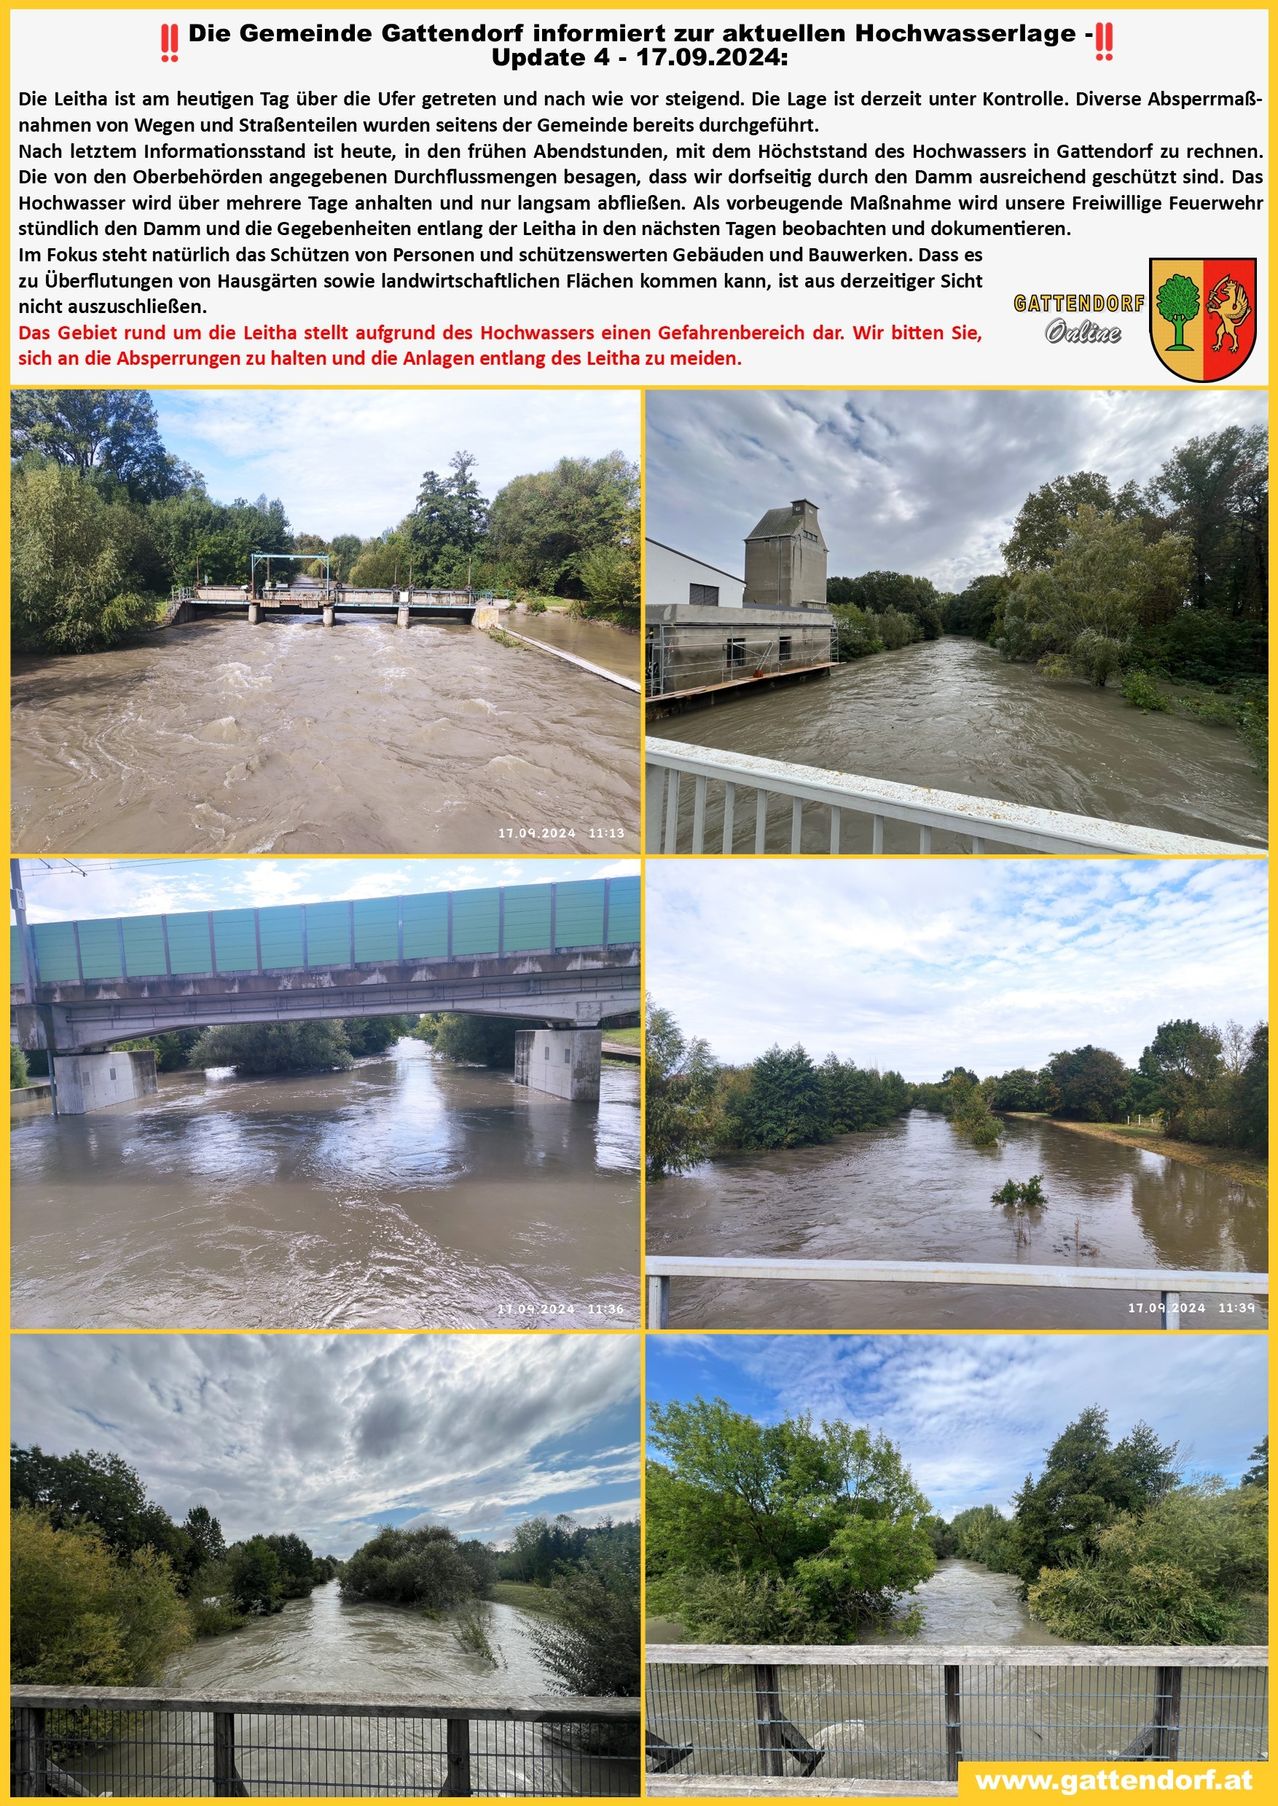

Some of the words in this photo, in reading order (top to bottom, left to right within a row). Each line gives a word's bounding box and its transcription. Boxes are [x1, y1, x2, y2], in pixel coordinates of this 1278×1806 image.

[189, 23, 231, 43] Die
[239, 23, 373, 43] Gemeinde
[381, 23, 525, 43] Gattendorf
[533, 23, 666, 43] informiert
[673, 28, 715, 43] zur
[722, 23, 846, 43] aktuellen
[855, 23, 1077, 47] Hochwasserlage
[492, 47, 586, 71] Update
[593, 47, 611, 66] 4
[636, 47, 788, 67] 17.09.2024:
[19, 90, 48, 107] Die
[54, 90, 108, 107] Leitha
[114, 90, 136, 107] ist
[142, 94, 170, 107] am
[177, 90, 254, 110] heutigen
[259, 91, 290, 110] Tag
[296, 90, 338, 107] über
[343, 90, 371, 107] die
[378, 90, 416, 107] Ufer
[421, 92, 497, 110] getreten
[503, 90, 538, 107] und
[544, 90, 586, 107] nach
[591, 90, 624, 107] wie
[630, 94, 660, 107] vor
[665, 90, 745, 110] steigend.
[752, 90, 781, 107] Die
[787, 91, 827, 110] Lage
[834, 90, 855, 107] ist
[860, 90, 922, 107] derzeit
[929, 92, 977, 107] unter
[983, 90, 1069, 107] Kontrolle.
[1076, 90, 1142, 107] Diverse
[1147, 90, 1263, 110] Absperrmaß-
[18, 116, 92, 133] nahmen
[95, 120, 129, 133] von
[134, 117, 195, 136] Wegen
[200, 116, 234, 133] und
[239, 116, 358, 133] Straßenteilen
[362, 116, 430, 133] wurden
[435, 116, 498, 133] seitens
[502, 116, 533, 133] der
[537, 116, 628, 133] Gemeinde
[633, 116, 695, 133] bereits
[698, 116, 819, 136] durchgeführt.
[19, 168, 48, 184] Die
[53, 172, 87, 185] von
[93, 168, 127, 185] den
[132, 168, 263, 185] Oberbehörden
[269, 168, 387, 188] angegebenen
[394, 168, 557, 188] Durchflussmengen
[563, 168, 641, 188] besagen,
[648, 168, 688, 184] dass
[693, 168, 723, 184] wir
[728, 168, 812, 188] dorfseitig
[817, 168, 868, 185] durch
[874, 168, 908, 185] den
[915, 169, 973, 185] Damm
[979, 168, 1086, 185] ausreichend
[1091, 168, 1177, 188] geschützt
[1182, 168, 1225, 185] sind.
[1232, 169, 1264, 184] Das
[18, 219, 99, 236] stündlich
[104, 219, 138, 236] den
[143, 221, 201, 236] Damm
[206, 219, 240, 236] und
[245, 219, 273, 236] die
[277, 219, 412, 240] Gegebenheiten
[417, 219, 484, 240] entlang
[488, 219, 518, 236] der
[523, 219, 576, 236] Leitha
[582, 219, 598, 236] in
[602, 219, 637, 236] den
[641, 219, 720, 236] nächsten
[725, 221, 777, 240] Tagen
[782, 219, 887, 236] beobachten
[891, 219, 925, 236] und
[930, 219, 1071, 236] dokumentieren.
[19, 247, 41, 262] Im
[47, 246, 98, 262] Fokus
[102, 246, 148, 262] steht
[152, 246, 230, 262] natürlich
[235, 246, 266, 262] das
[270, 246, 350, 262] Schützen
[354, 250, 387, 263] von
[393, 247, 475, 262] Personen
[480, 246, 513, 262] und
[518, 246, 668, 262] schützenswerten
[672, 246, 764, 263] Gebäuden
[769, 246, 804, 262] und
[808, 246, 913, 262] Bauwerken.
[918, 247, 959, 262] Dass
[964, 250, 983, 262] es
[18, 276, 38, 289] zu
[45, 271, 173, 292] Überflutungen
[178, 276, 211, 289] von
[217, 273, 318, 292] Hausgärten
[323, 272, 376, 289] sowie
[381, 272, 560, 289] landwirtschaftlichen
[566, 272, 634, 289] Flächen
[640, 272, 718, 289] kommen
[724, 272, 772, 292] kann,
[778, 272, 799, 289] ist
[804, 276, 835, 289] aus
[840, 272, 936, 292] derzeitiger
[940, 272, 983, 289] Sicht
[18, 297, 63, 314] nicht
[67, 297, 207, 314] auszuschließen.
[1013, 293, 1146, 313] GATTENDORF
[18, 325, 51, 341] Das
[57, 323, 118, 340] Gebiet
[124, 323, 166, 341] rund
[173, 328, 202, 340] um
[208, 323, 237, 340] die
[244, 323, 297, 341] Leitha
[303, 323, 349, 341] stellt
[355, 323, 436, 344] aufgrund
[442, 323, 473, 341] des
[480, 324, 595, 341] Hochwassers
[601, 324, 651, 341] einen
[658, 323, 805, 341] Gefahrenbereich
[812, 324, 845, 340] dar.
[852, 324, 885, 341] Wir
[891, 324, 944, 341] bitten
[951, 324, 982, 343] Sie,
[1045, 316, 1123, 345] Online
[18, 349, 52, 366] sich
[57, 353, 79, 366] an
[84, 349, 112, 366] die
[116, 349, 241, 370] Absperrungen
[245, 353, 266, 366] zu
[270, 349, 327, 366] halten
[332, 349, 366, 366] und
[371, 349, 398, 366] die
[402, 349, 475, 370] Anlagen
[479, 349, 546, 370] entlang
[551, 349, 582, 366] des
[587, 349, 641, 366] Leitha
[645, 353, 665, 366] zu
[670, 349, 742, 366] meiden.
